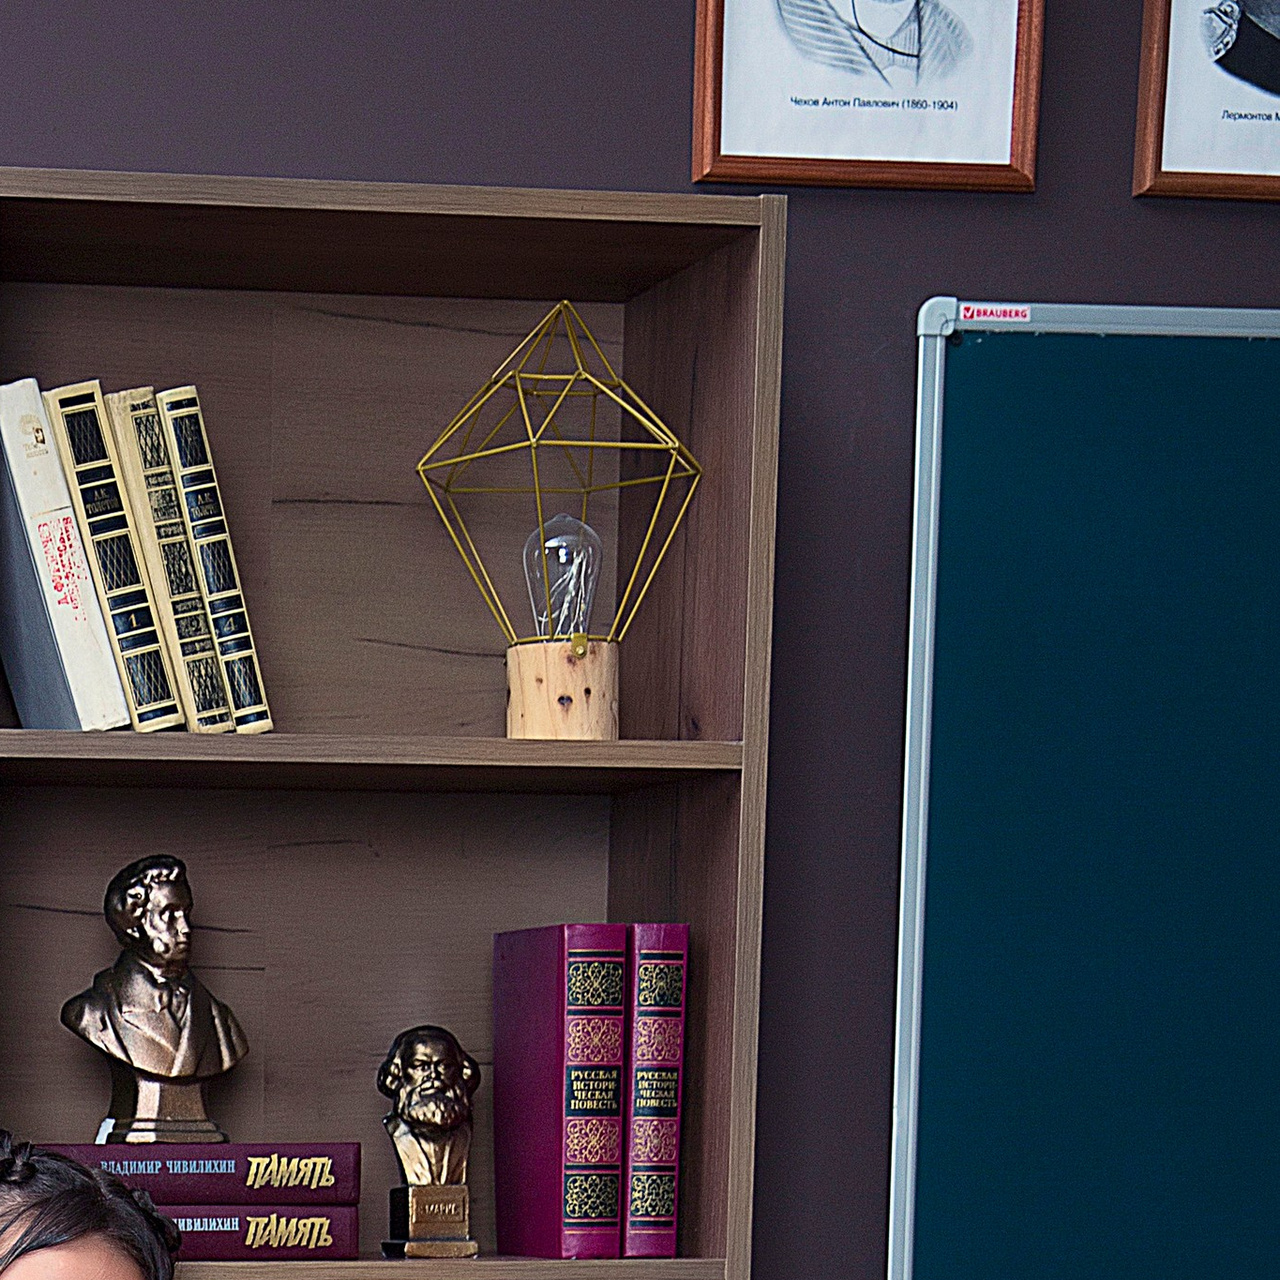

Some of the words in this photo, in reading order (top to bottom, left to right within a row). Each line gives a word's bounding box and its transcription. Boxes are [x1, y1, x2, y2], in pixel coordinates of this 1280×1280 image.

[790, 97, 819, 106] Чехов
[822, 97, 850, 107] Антон
[853, 98, 899, 108] Павлович
[902, 99, 958, 111] (1860-1904)
[1221, 110, 1273, 121] Лермонтов
[976, 307, 1027, 318] BRAUBERG
[128, 613, 139, 629] 1
[223, 616, 237, 632] 4
[571, 1070, 618, 1080] РУССКАЯ
[636, 1071, 678, 1081] РУССКАЯ
[572, 1080, 618, 1091] ИСТОРИ-
[638, 1080, 678, 1090] ИСТОРИ-
[574, 1090, 614, 1101] ЧЕСКАЯ
[640, 1089, 676, 1099] ЧЕСКАЯ
[570, 1099, 618, 1110] ПОВЕСТЬ
[636, 1098, 678, 1108] ПОВЕСТЬ
[100, 1160, 162, 1177] ВЛАДИМИР
[166, 1159, 236, 1174] ЧИВИЛИХИН
[245, 1153, 336, 1189] ПАМЯТЬ
[244, 1213, 334, 1249] ПАМЯТЬ
